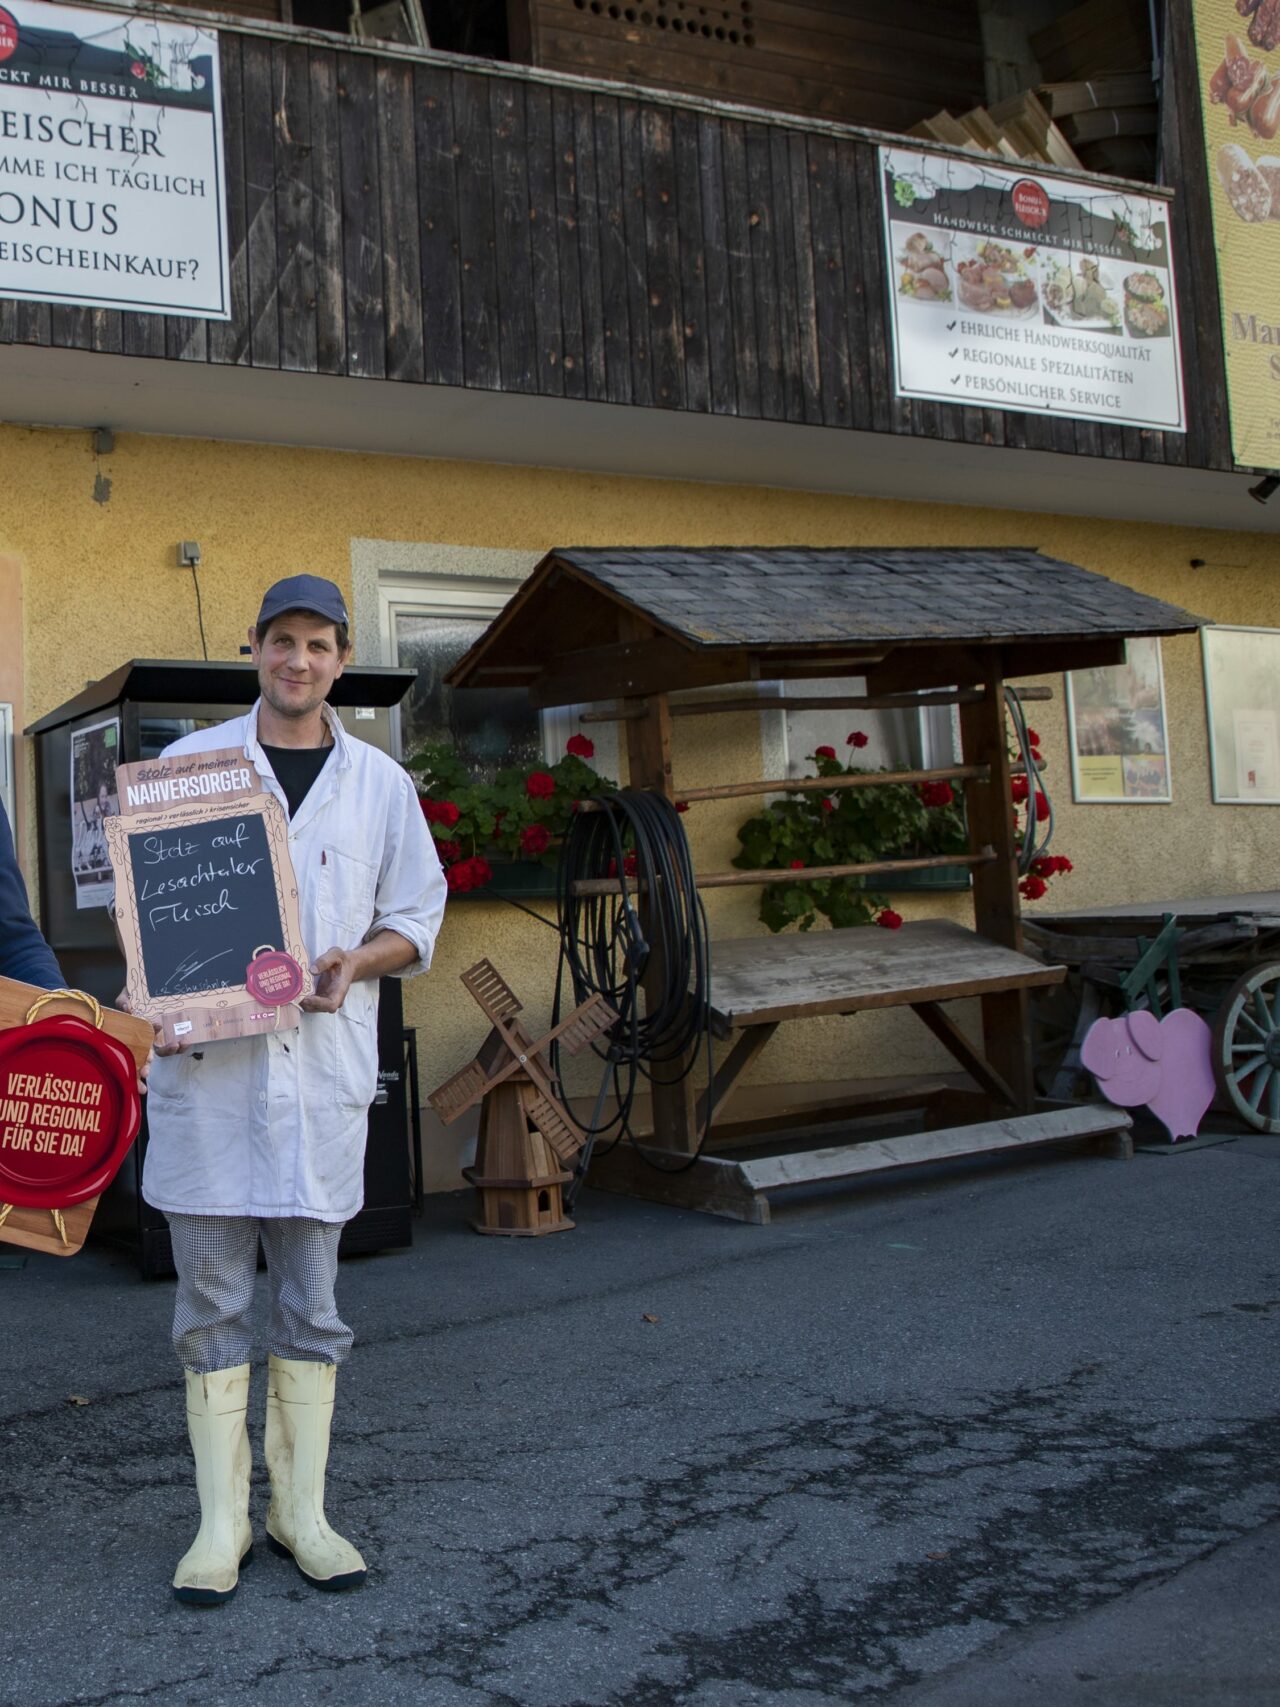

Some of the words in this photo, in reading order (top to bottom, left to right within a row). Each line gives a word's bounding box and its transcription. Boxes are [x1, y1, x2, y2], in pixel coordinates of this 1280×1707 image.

[39, 75, 72, 90] MIR
[80, 80, 139, 99] BESSER
[55, 162, 98, 185] ICH
[106, 167, 206, 197] TÄGLICH
[960, 321, 1020, 343] EHRLICHE
[1024, 328, 1152, 362] HANDWERKSQUALITÄT
[963, 348, 1036, 371] REGIONALE
[1041, 357, 1134, 384] SPEZIALITÄTEN
[965, 375, 1066, 401] PERSÖNLICHER
[1069, 388, 1122, 409] SERVICE
[175, 763, 195, 775] auf
[198, 758, 238, 771] meinen
[127, 768, 252, 806] NAHVERSORGER
[136, 815, 163, 824] regional
[169, 808, 204, 819] verlässlich
[209, 802, 250, 812] krisensicher
[211, 823, 250, 849] auf
[7, 1072, 103, 1106] VERLÄSSLICH
[30, 1103, 101, 1133] REGIONAL
[1, 1123, 33, 1151] FÜR
[33, 1130, 60, 1155] SIE
[59, 1132, 86, 1158] DA!
